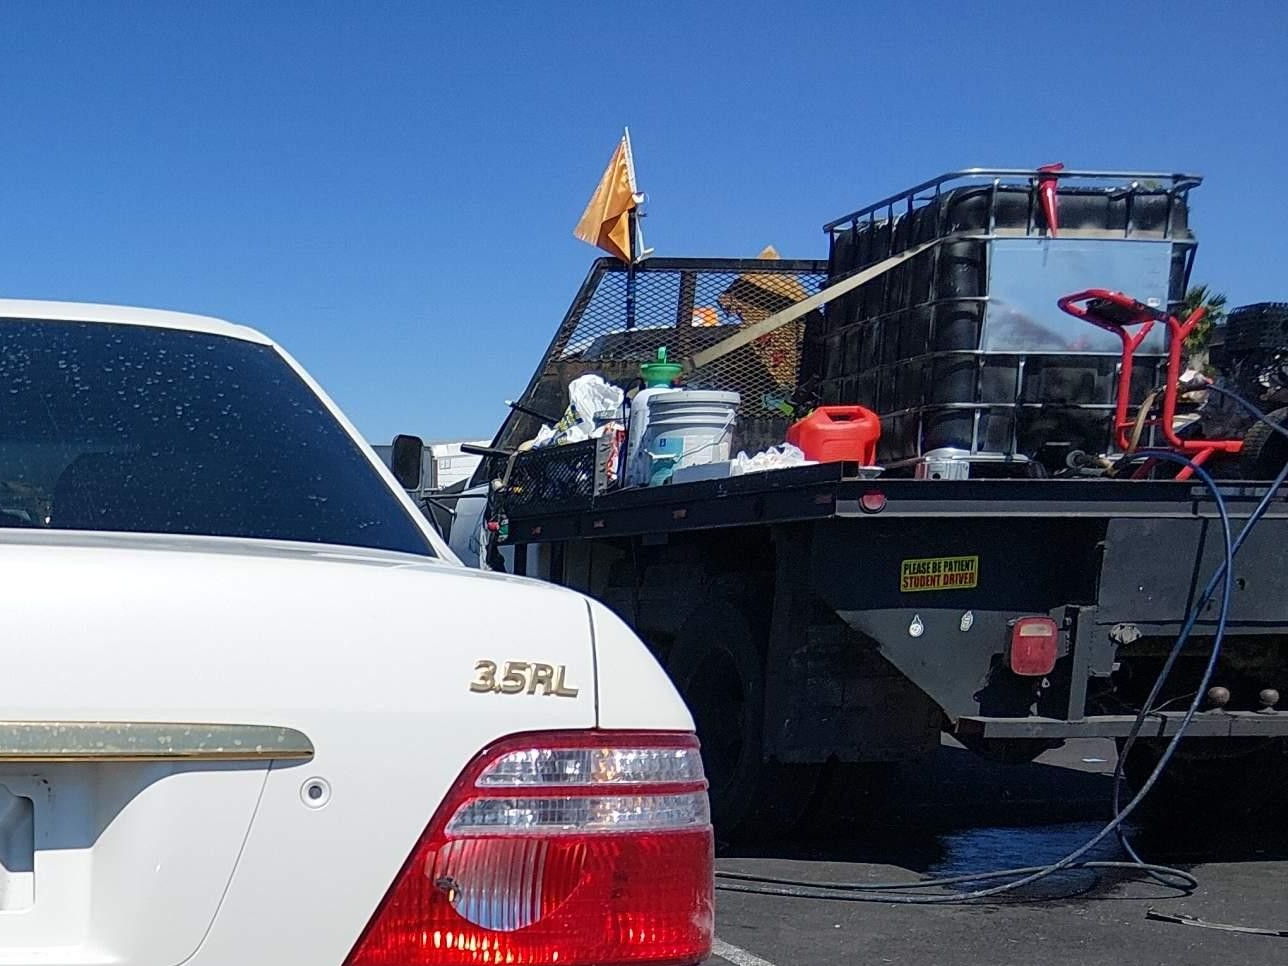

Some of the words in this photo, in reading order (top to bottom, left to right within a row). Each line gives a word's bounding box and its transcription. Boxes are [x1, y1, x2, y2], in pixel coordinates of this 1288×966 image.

[903, 561, 931, 575] PLEASE
[931, 560, 942, 573] BE
[943, 559, 975, 572] PATIENT
[903, 574, 941, 588] STUDENT
[943, 572, 975, 586] DRIVER
